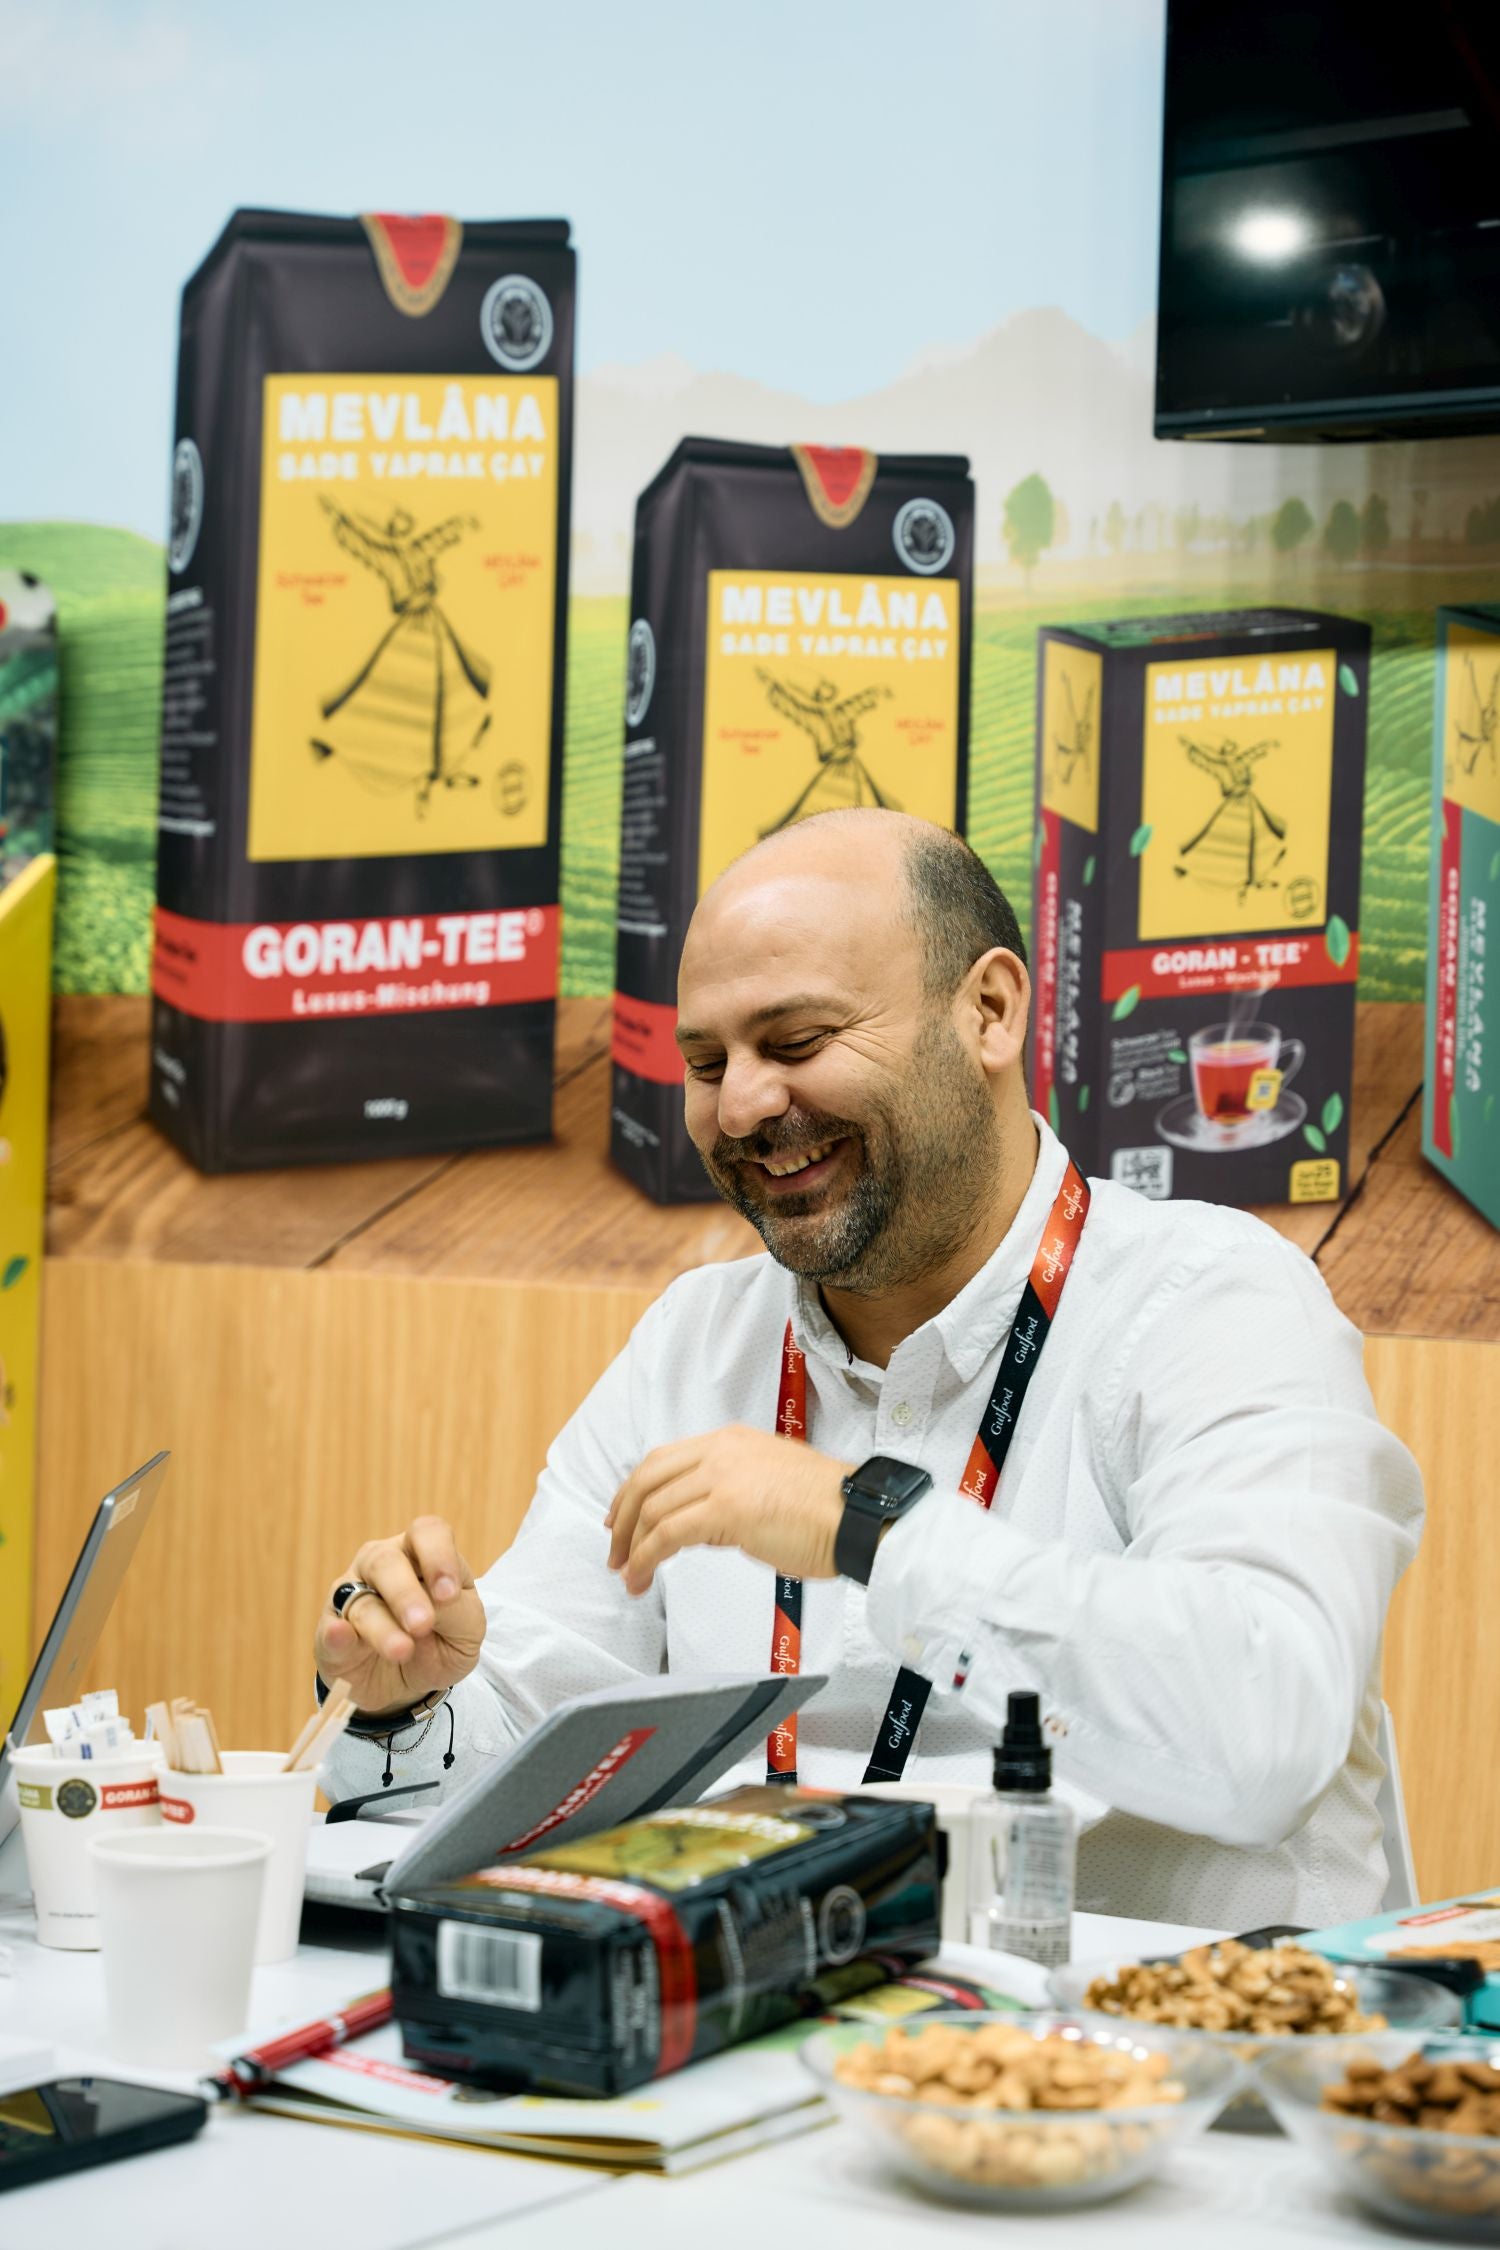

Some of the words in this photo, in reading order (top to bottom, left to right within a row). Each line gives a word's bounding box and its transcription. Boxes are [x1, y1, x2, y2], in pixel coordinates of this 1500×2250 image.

[278, 453, 358, 480] SADE
[370, 452, 486, 478] YAPRAK
[721, 634, 789, 656] SADE
[799, 635, 896, 657] YAPRAK
[1152, 947, 1237, 975] GORAN
[1062, 1184, 1083, 1221] Gulfood
[1041, 1239, 1065, 1283] Gulfood
[1014, 1317, 1038, 1364] Gulfood
[991, 1388, 1013, 1436] Gulfood
[780, 1574, 800, 1598] food
[774, 1635, 796, 1684] Gulfoo
[888, 1700, 912, 1748] Gulfood
